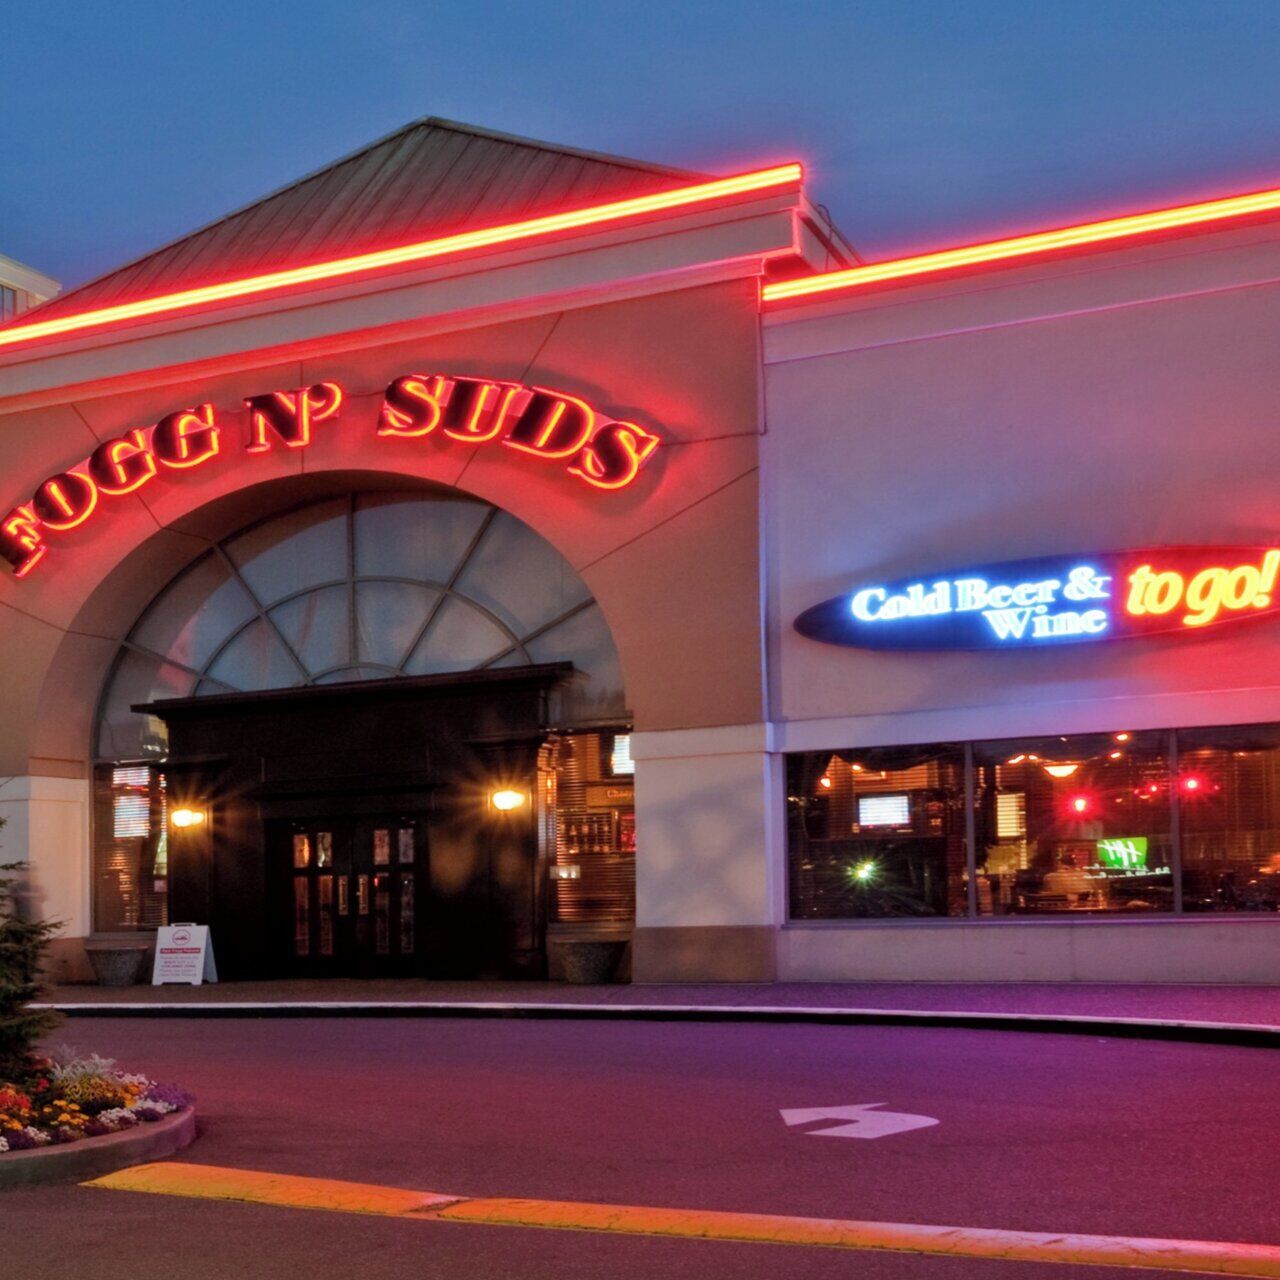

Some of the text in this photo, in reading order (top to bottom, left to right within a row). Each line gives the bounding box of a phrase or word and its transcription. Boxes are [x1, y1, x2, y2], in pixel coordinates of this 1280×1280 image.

[377, 375, 662, 490] SUDS
[851, 566, 1113, 621] Cold Beer &
[1126, 549, 1280, 626] to go!
[981, 604, 1108, 640] Wine
